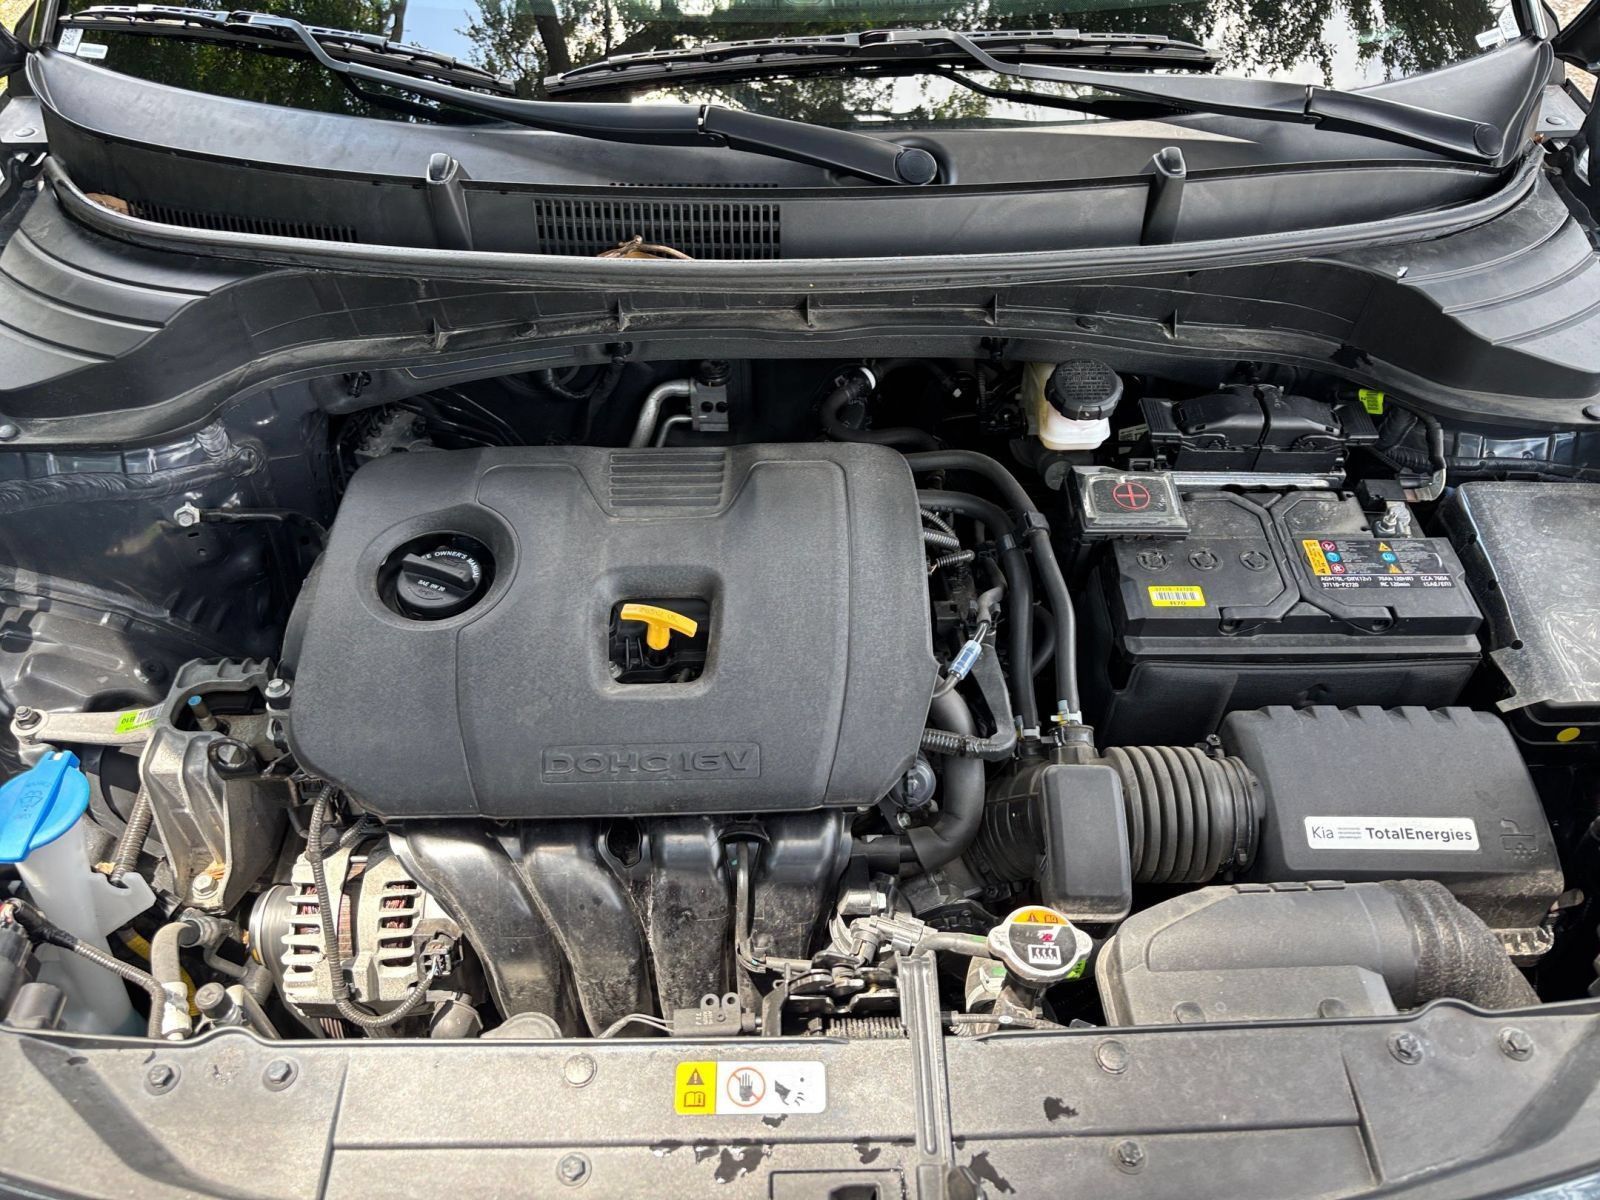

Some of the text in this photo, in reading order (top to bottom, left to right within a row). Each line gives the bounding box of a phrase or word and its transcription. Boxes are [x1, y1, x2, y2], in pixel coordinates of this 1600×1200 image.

[466, 558, 480, 579] MANUAL
[544, 751, 748, 775] DOHC 16V
[1311, 826, 1472, 843] Kia TotalEnergies
